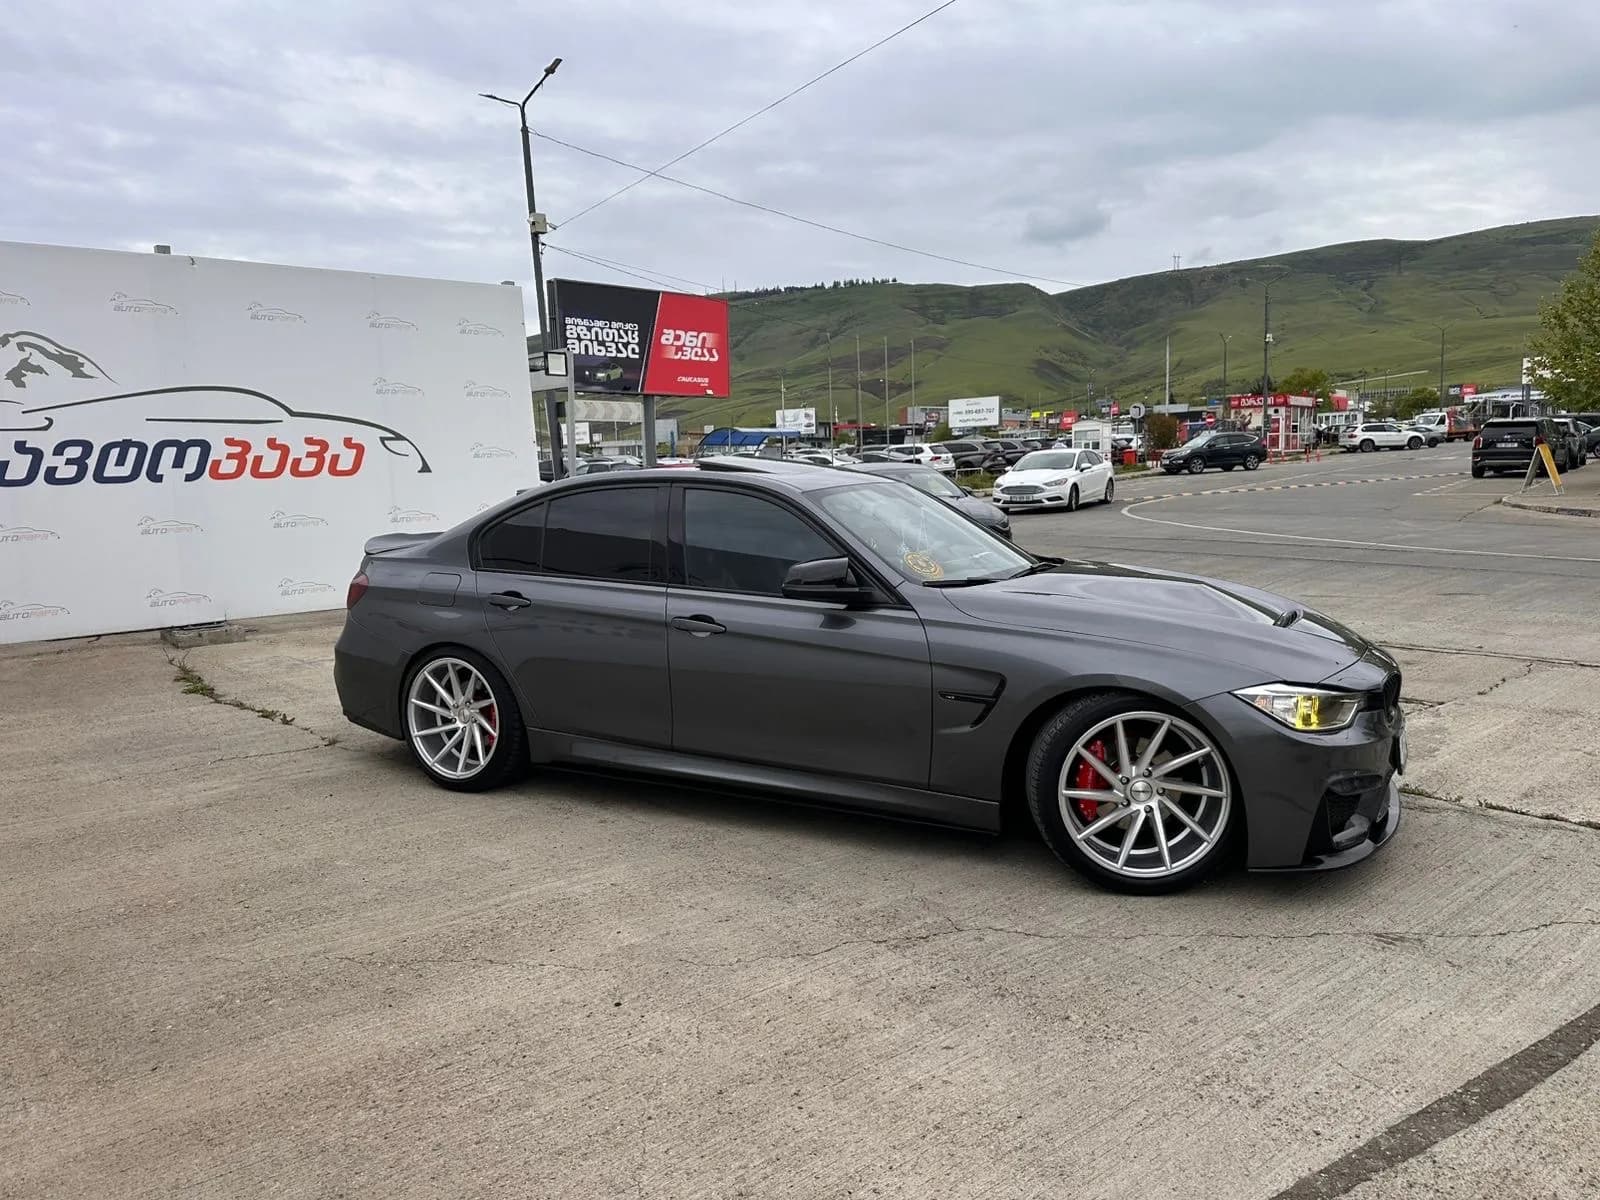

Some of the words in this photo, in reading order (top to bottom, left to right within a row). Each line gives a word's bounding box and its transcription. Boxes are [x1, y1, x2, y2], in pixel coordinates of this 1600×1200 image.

[566, 325, 640, 343] გზითაც
[567, 339, 640, 359] მიხვალ
[0, 437, 366, 487] ავტოპაპა
